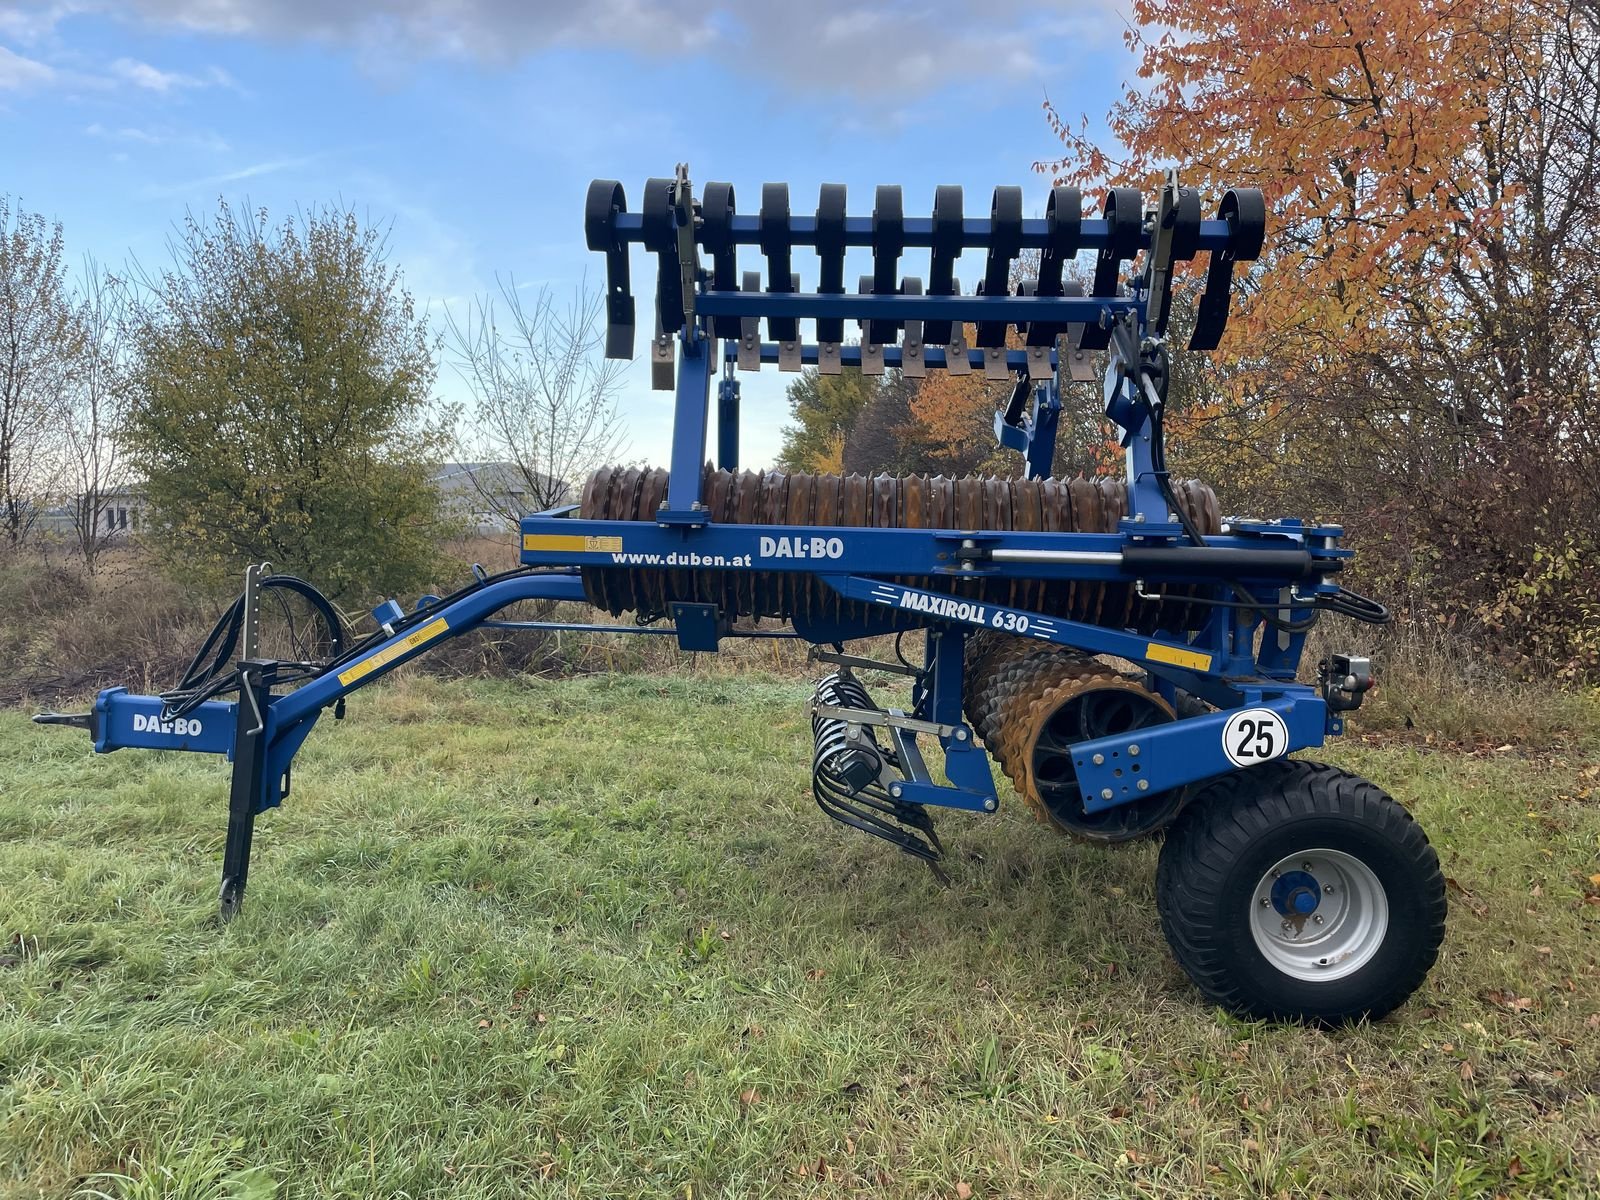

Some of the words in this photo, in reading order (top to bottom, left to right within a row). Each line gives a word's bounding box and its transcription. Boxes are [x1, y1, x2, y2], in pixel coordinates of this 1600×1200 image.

[611, 552, 752, 567] www.duben.at
[899, 590, 986, 625] MAXIROLL
[991, 610, 1029, 633] 630
[1236, 719, 1274, 758] 25
